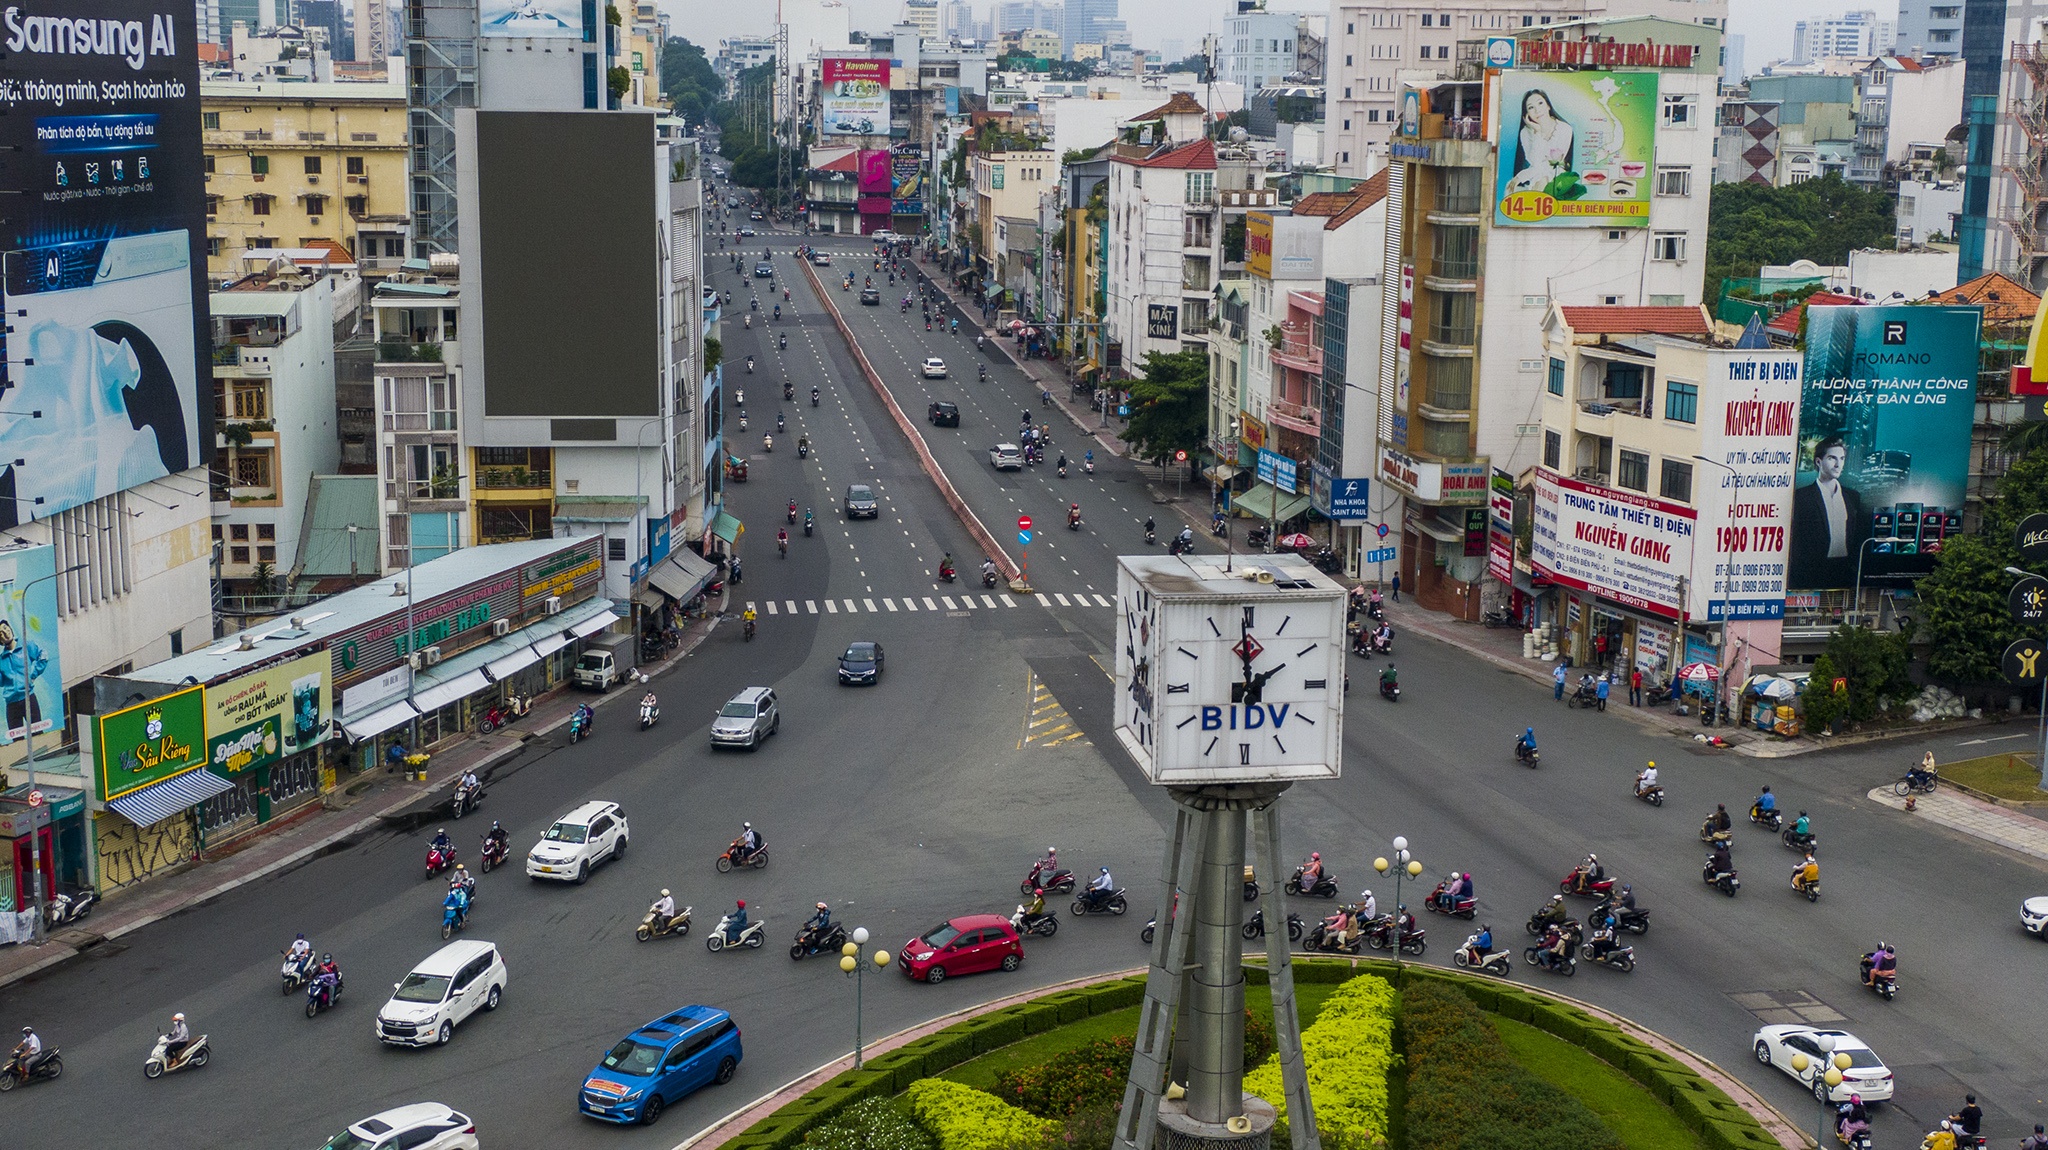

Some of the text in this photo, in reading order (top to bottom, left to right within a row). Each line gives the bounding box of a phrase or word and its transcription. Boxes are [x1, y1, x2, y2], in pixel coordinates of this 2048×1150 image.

[5, 6, 175, 70] Samsung AI
[1592, 37, 1625, 70] VIỆN
[1627, 37, 1661, 66] HOÀI
[1662, 45, 1693, 67] ANH
[845, 61, 879, 71] Havoline
[24, 78, 186, 107] thông minh, Sạch hoàn hảo
[37, 126, 58, 139] Phân
[59, 125, 75, 138] tích
[75, 126, 86, 141] độ
[105, 125, 113, 141] tự
[114, 125, 133, 141] động
[134, 121, 144, 136] tối
[145, 124, 154, 135] ưu
[892, 147, 921, 155] Dr.Care
[1505, 197, 1554, 216] 14-16
[1562, 204, 1582, 215] ĐIỆN
[1585, 204, 1604, 213] BIÊN
[1629, 205, 1639, 214] Q1
[47, 258, 59, 278] AI
[1888, 324, 1904, 341] R
[1856, 353, 1931, 365] ROMANO
[1729, 356, 1798, 384] THIẾT BỊ ĐIỆN
[1812, 376, 1969, 390] HƯƠNG THÀNH CÔNG
[1832, 390, 1947, 405] CHẤT ĐÀN ÔNG
[1725, 388, 1795, 436] NGUYỄN GIANG
[1726, 452, 1736, 464] UY
[1736, 449, 1747, 464] TÍN
[1752, 447, 1769, 464] CHẤT
[1768, 450, 1791, 467] LƯỢNG
[1443, 475, 1465, 489] HOÀI
[1468, 476, 1486, 489] ANH
[1722, 472, 1730, 488] LÀ
[1731, 472, 1746, 488] TÊU
[1746, 472, 1757, 488] CHÍ
[1757, 472, 1776, 487] HÀNG
[1585, 485, 1659, 509] www.nguyengiang.vn
[1472, 511, 1482, 520] ÁC
[1564, 493, 1691, 537] TRUNG TÂM THIẾT BỊ ĐIỆN
[1728, 504, 1779, 518] HOTLINE:
[1469, 522, 1484, 530] QUY
[1575, 521, 1671, 564] NGUYỄN GIANG
[1717, 526, 1784, 552] 1900 1778
[1588, 584, 1618, 600] HOTLINE:
[1619, 592, 1648, 609] 19001778
[1720, 603, 1735, 616] ĐỆN
[1737, 603, 1751, 614] BIÊN
[1753, 602, 1765, 614] PHỦ
[1771, 605, 1778, 614] Q1
[1638, 645, 1656, 656] OSRAM
[238, 696, 254, 712] RAU
[255, 688, 267, 704] MÁ
[235, 714, 245, 724] CHO
[246, 706, 262, 722] BỚT
[1201, 704, 1290, 731] BIDV
[132, 743, 158, 773] Sầu
[160, 735, 190, 762] Riêng
